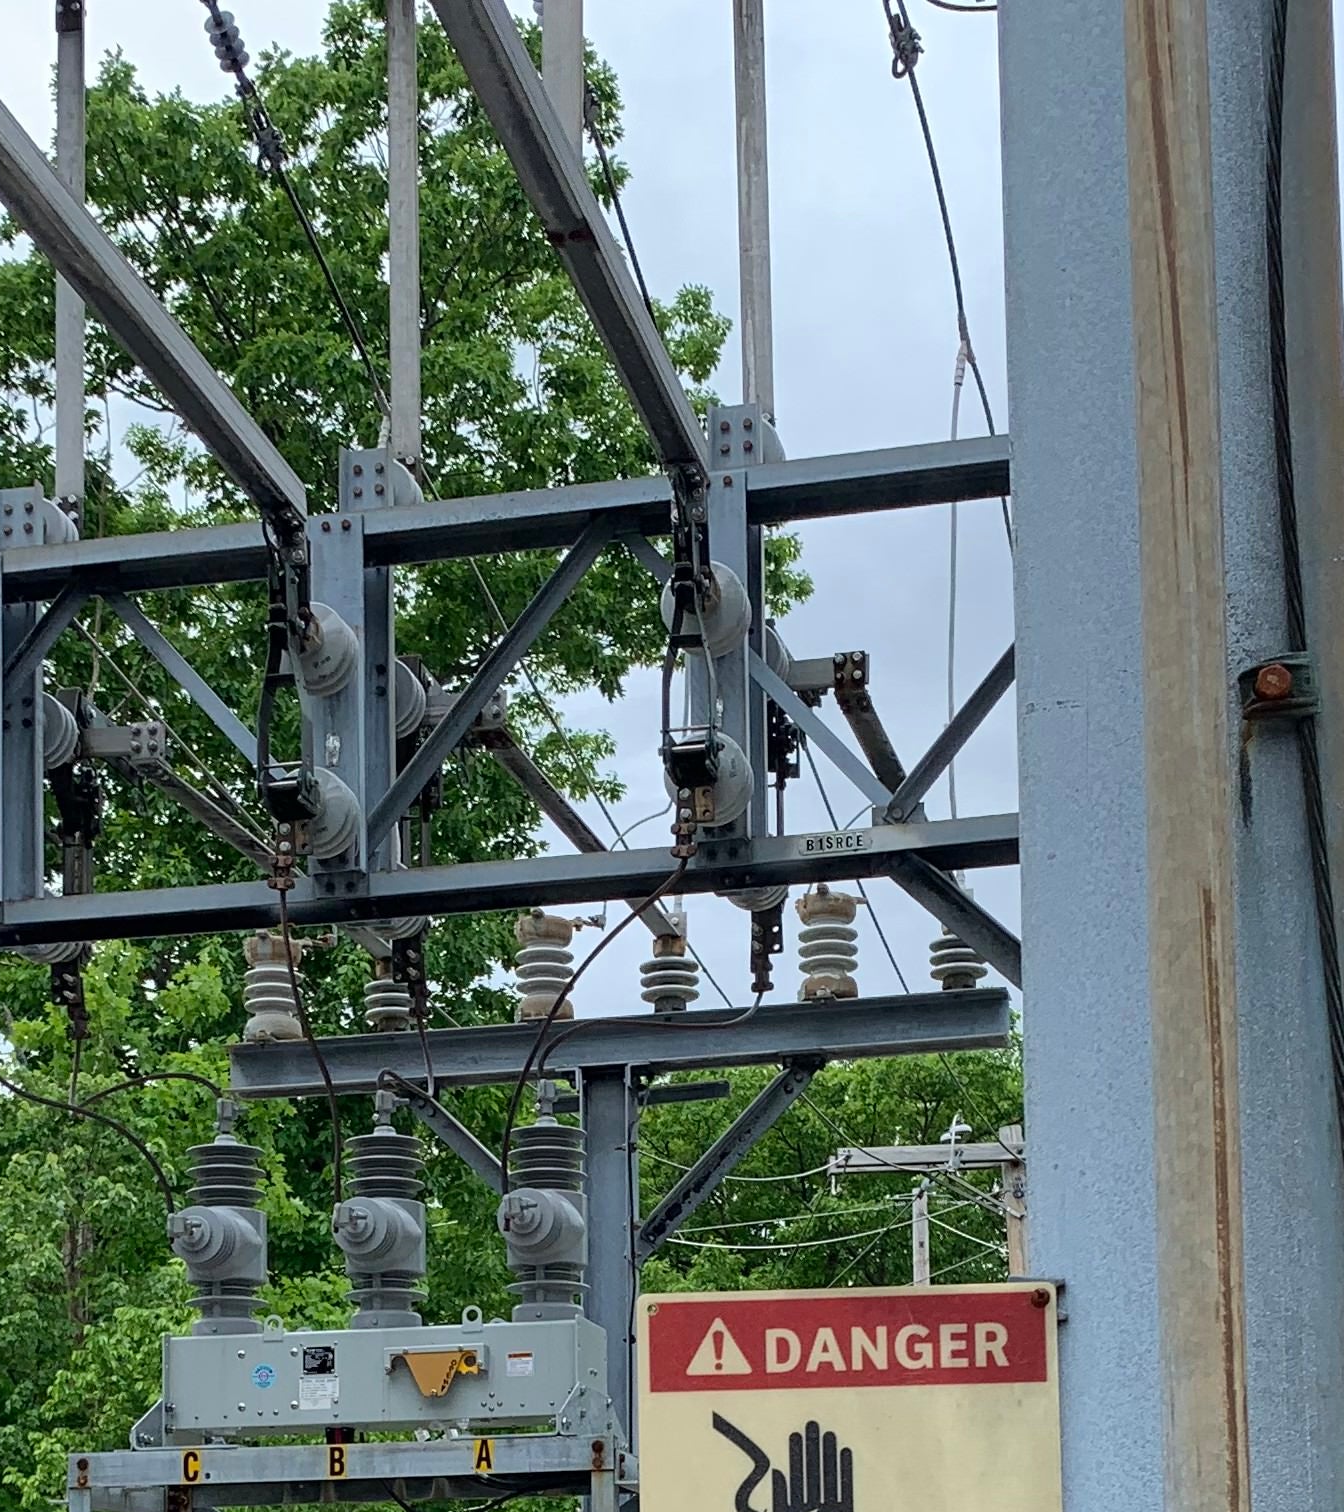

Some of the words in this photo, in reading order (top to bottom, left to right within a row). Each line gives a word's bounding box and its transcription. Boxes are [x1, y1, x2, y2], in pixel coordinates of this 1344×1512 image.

[764, 1321, 1010, 1374] DANGER
[183, 1451, 199, 1482] C
[329, 1446, 345, 1476] B
[476, 1439, 493, 1469] A
